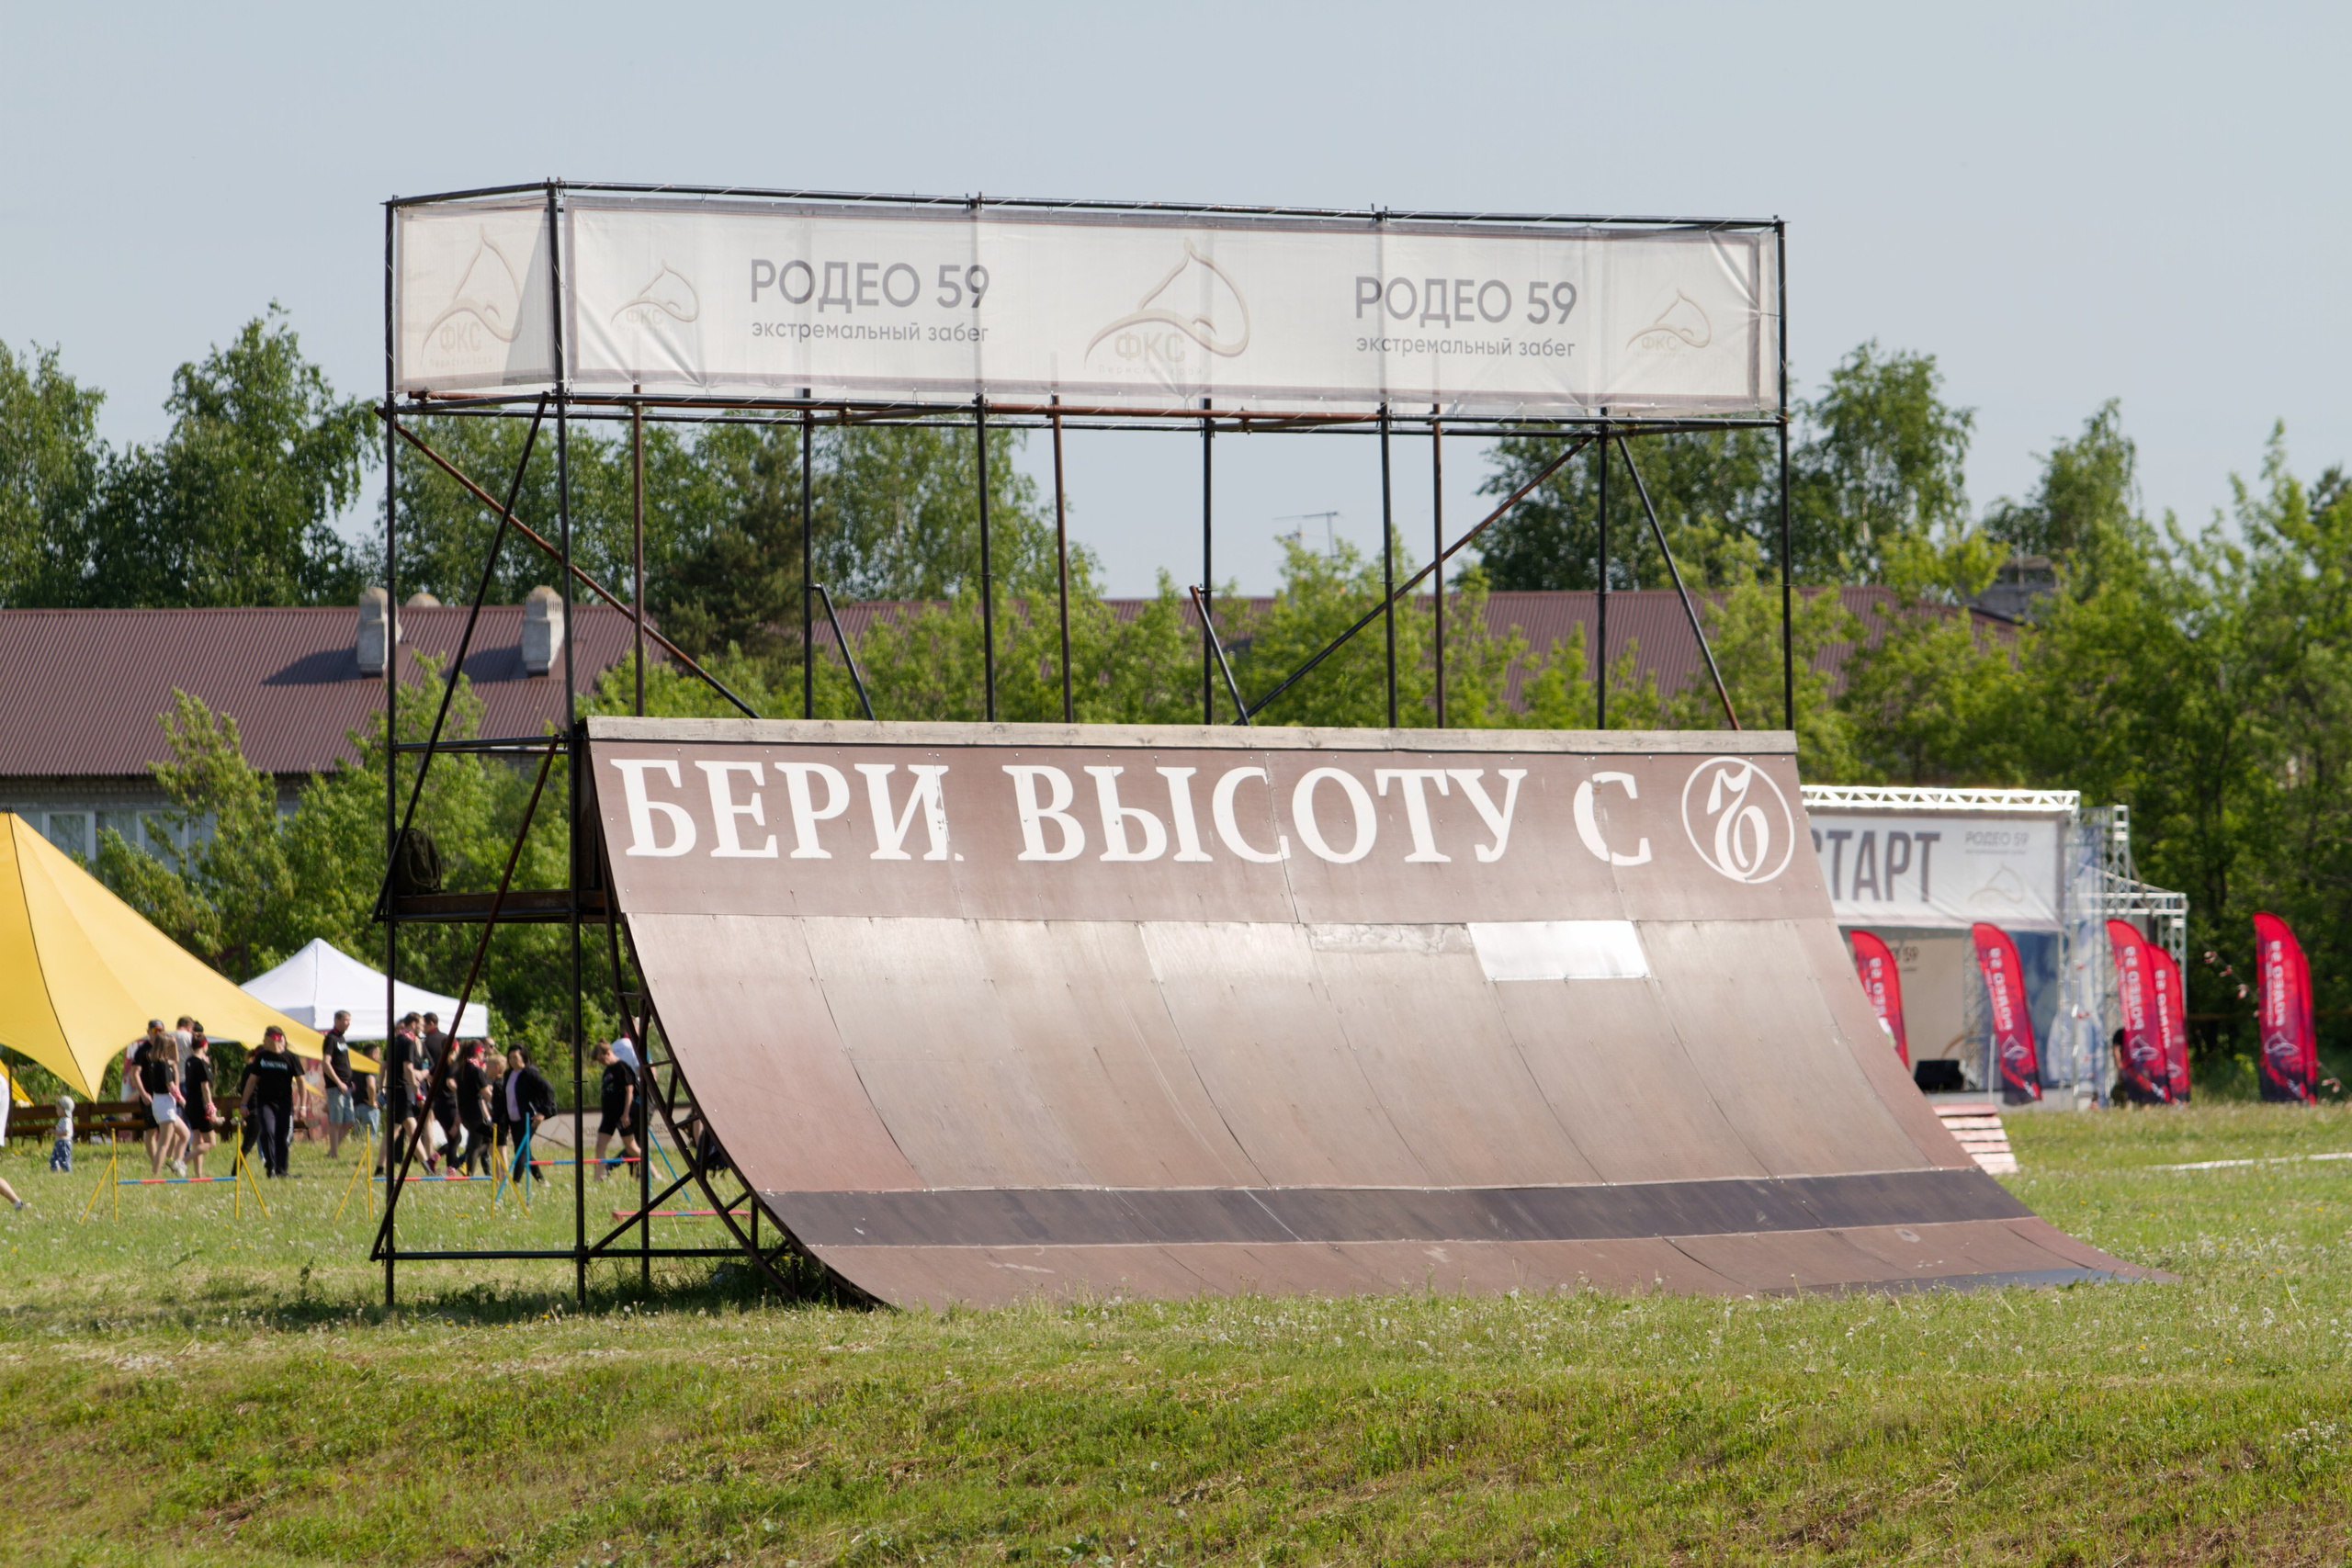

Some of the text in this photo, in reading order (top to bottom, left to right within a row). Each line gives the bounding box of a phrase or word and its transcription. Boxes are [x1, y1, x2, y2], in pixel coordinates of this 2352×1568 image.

[751, 259, 989, 313] РОДЕО 59
[1355, 276, 1577, 328] РОДЕО 59
[439, 321, 481, 353] ФКС
[751, 321, 989, 343] экстремальный забег
[1114, 332, 1186, 362] ФКС
[1355, 337, 1576, 357] экстремальный забег
[610, 759, 965, 862] БЕРИ
[1001, 764, 1528, 863] ВЫСОТУ
[1573, 771, 1652, 866] С
